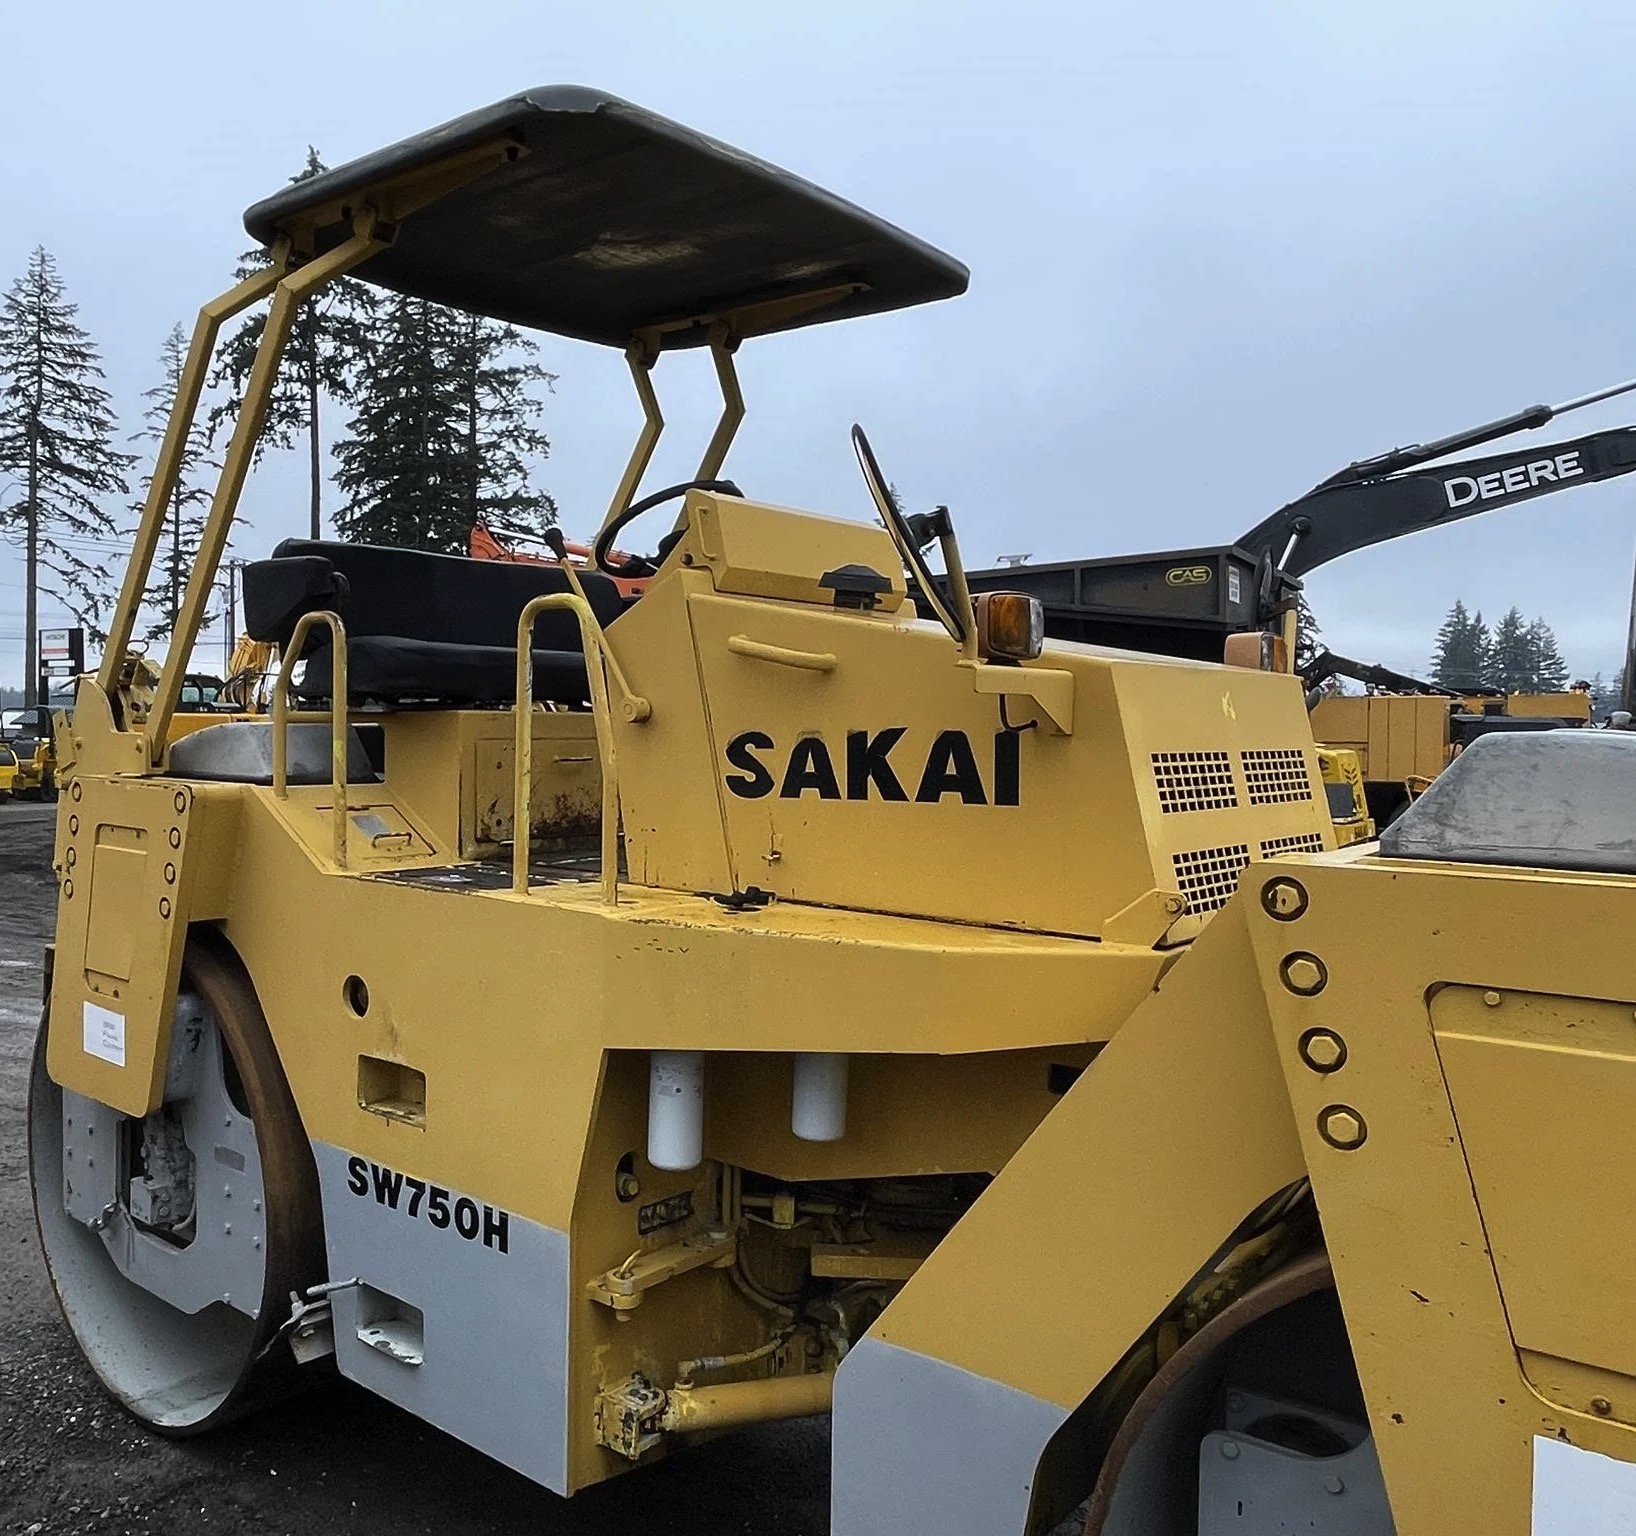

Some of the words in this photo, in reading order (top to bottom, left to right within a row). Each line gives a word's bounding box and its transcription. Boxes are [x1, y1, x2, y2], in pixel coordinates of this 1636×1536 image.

[1444, 451, 1584, 508] DEERE
[1169, 567, 1208, 583] CAS
[725, 726, 1020, 807] SAKAI
[347, 1156, 509, 1254] SW750H
